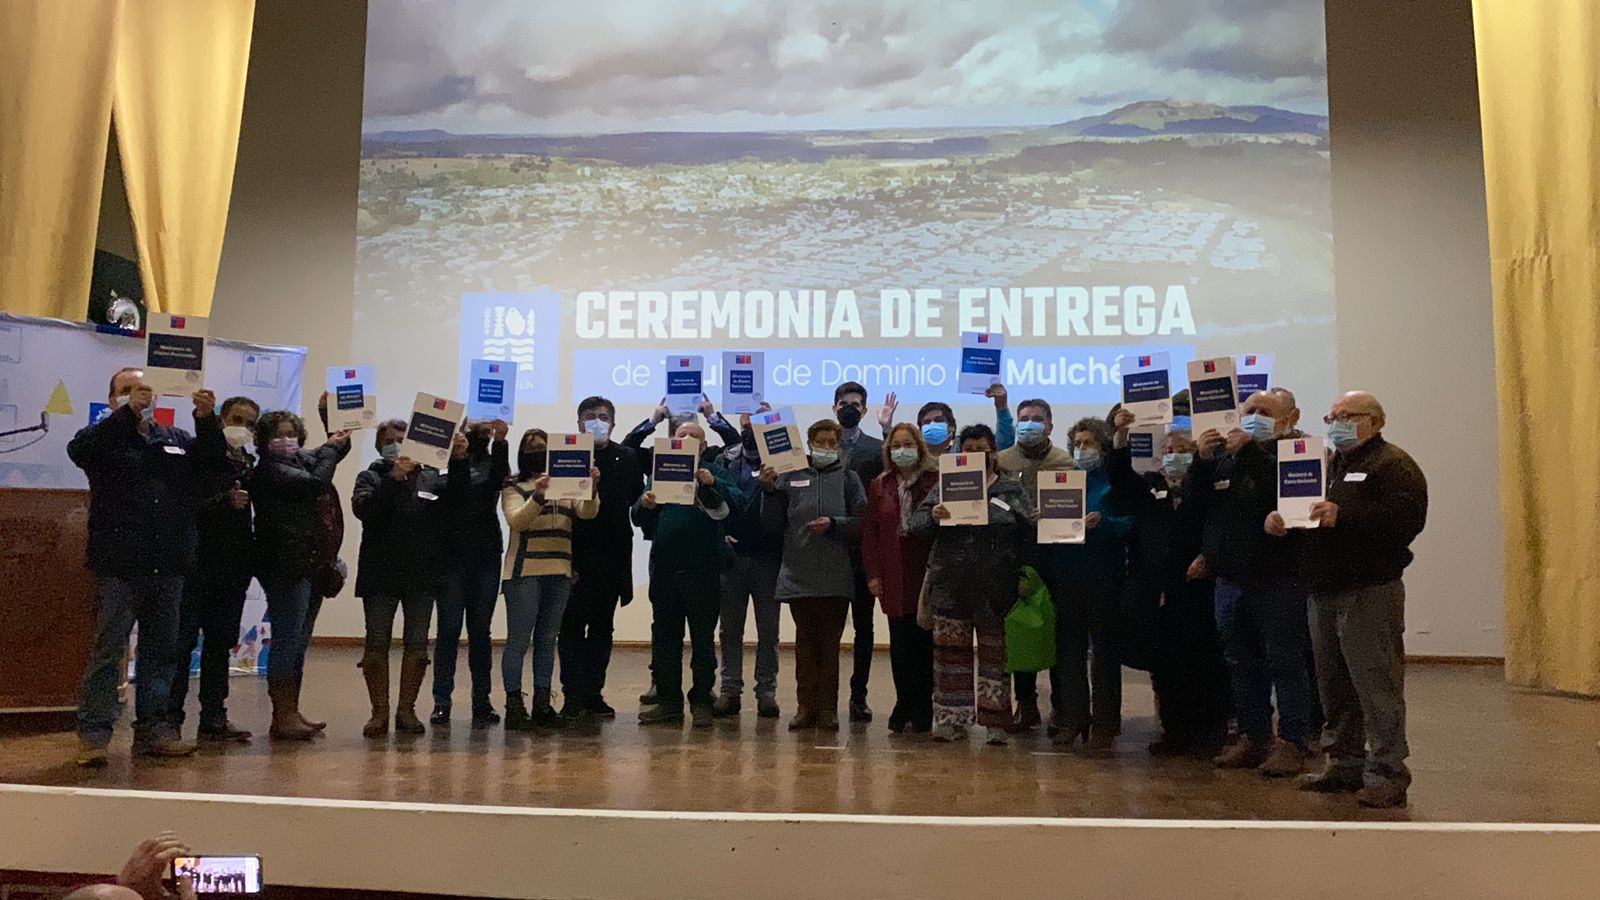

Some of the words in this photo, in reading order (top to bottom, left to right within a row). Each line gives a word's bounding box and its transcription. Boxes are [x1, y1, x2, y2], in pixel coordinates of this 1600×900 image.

[576, 289, 864, 339] CEREMONIA
[880, 288, 943, 338] DE
[959, 285, 1197, 337] ENTREGA
[612, 359, 650, 386] de
[772, 358, 812, 386] de
[821, 357, 946, 386] Dominio
[1006, 354, 1121, 385] Mulché
